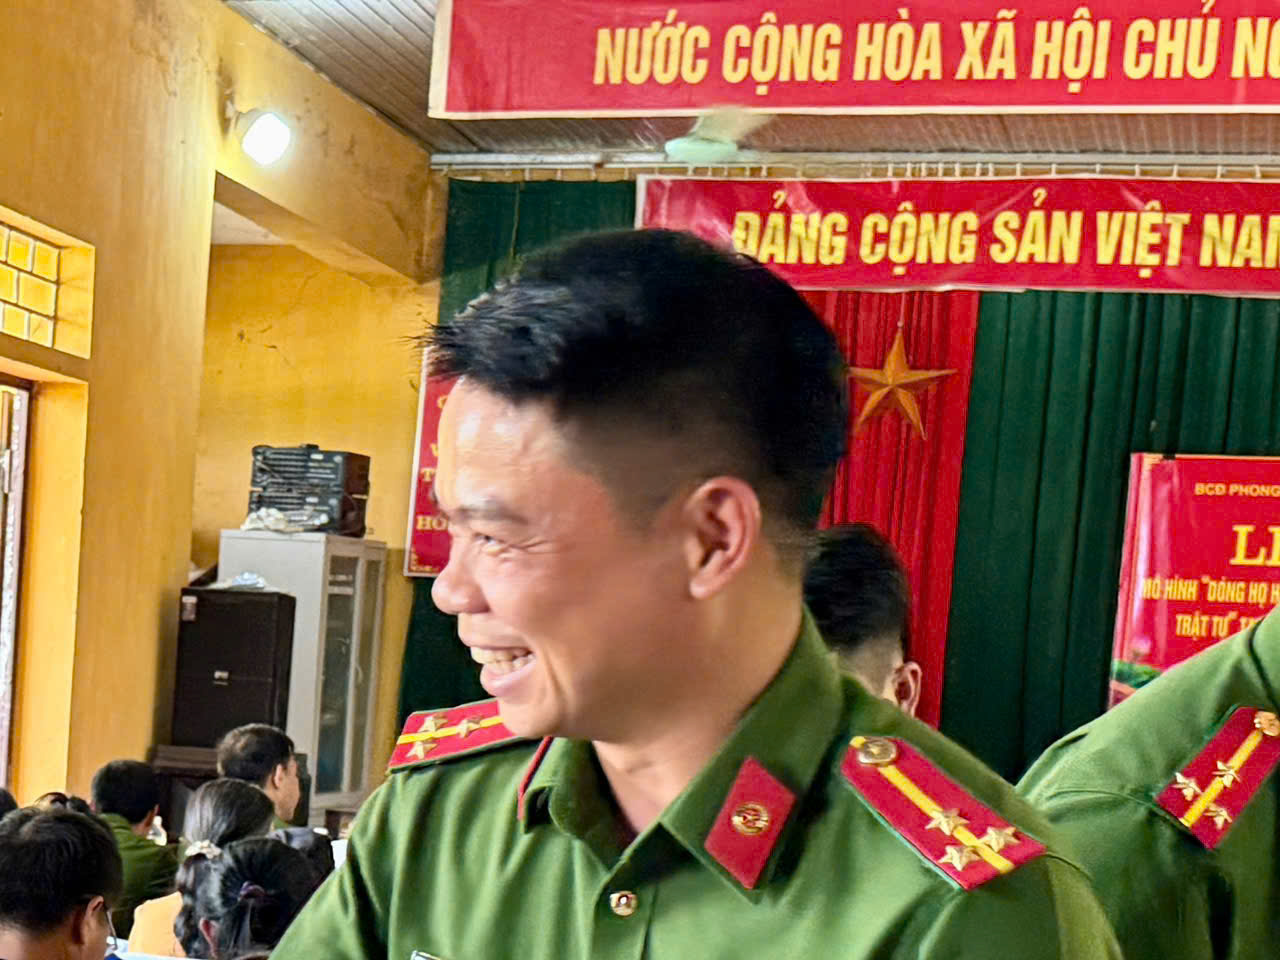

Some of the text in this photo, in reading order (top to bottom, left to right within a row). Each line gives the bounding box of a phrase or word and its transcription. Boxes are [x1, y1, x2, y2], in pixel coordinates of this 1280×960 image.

[593, 9, 710, 84] NƯỚC
[722, 12, 842, 95] CỘNG
[853, 8, 942, 81] HÒA
[954, 9, 1017, 80] XÃ
[1030, 7, 1111, 93] HỘI
[1123, 0, 1220, 79] CHỦ
[731, 191, 849, 265] ĐẢNG
[859, 201, 979, 276] CỘNG
[989, 187, 1084, 264] SẢN
[1096, 200, 1191, 278] VIỆT
